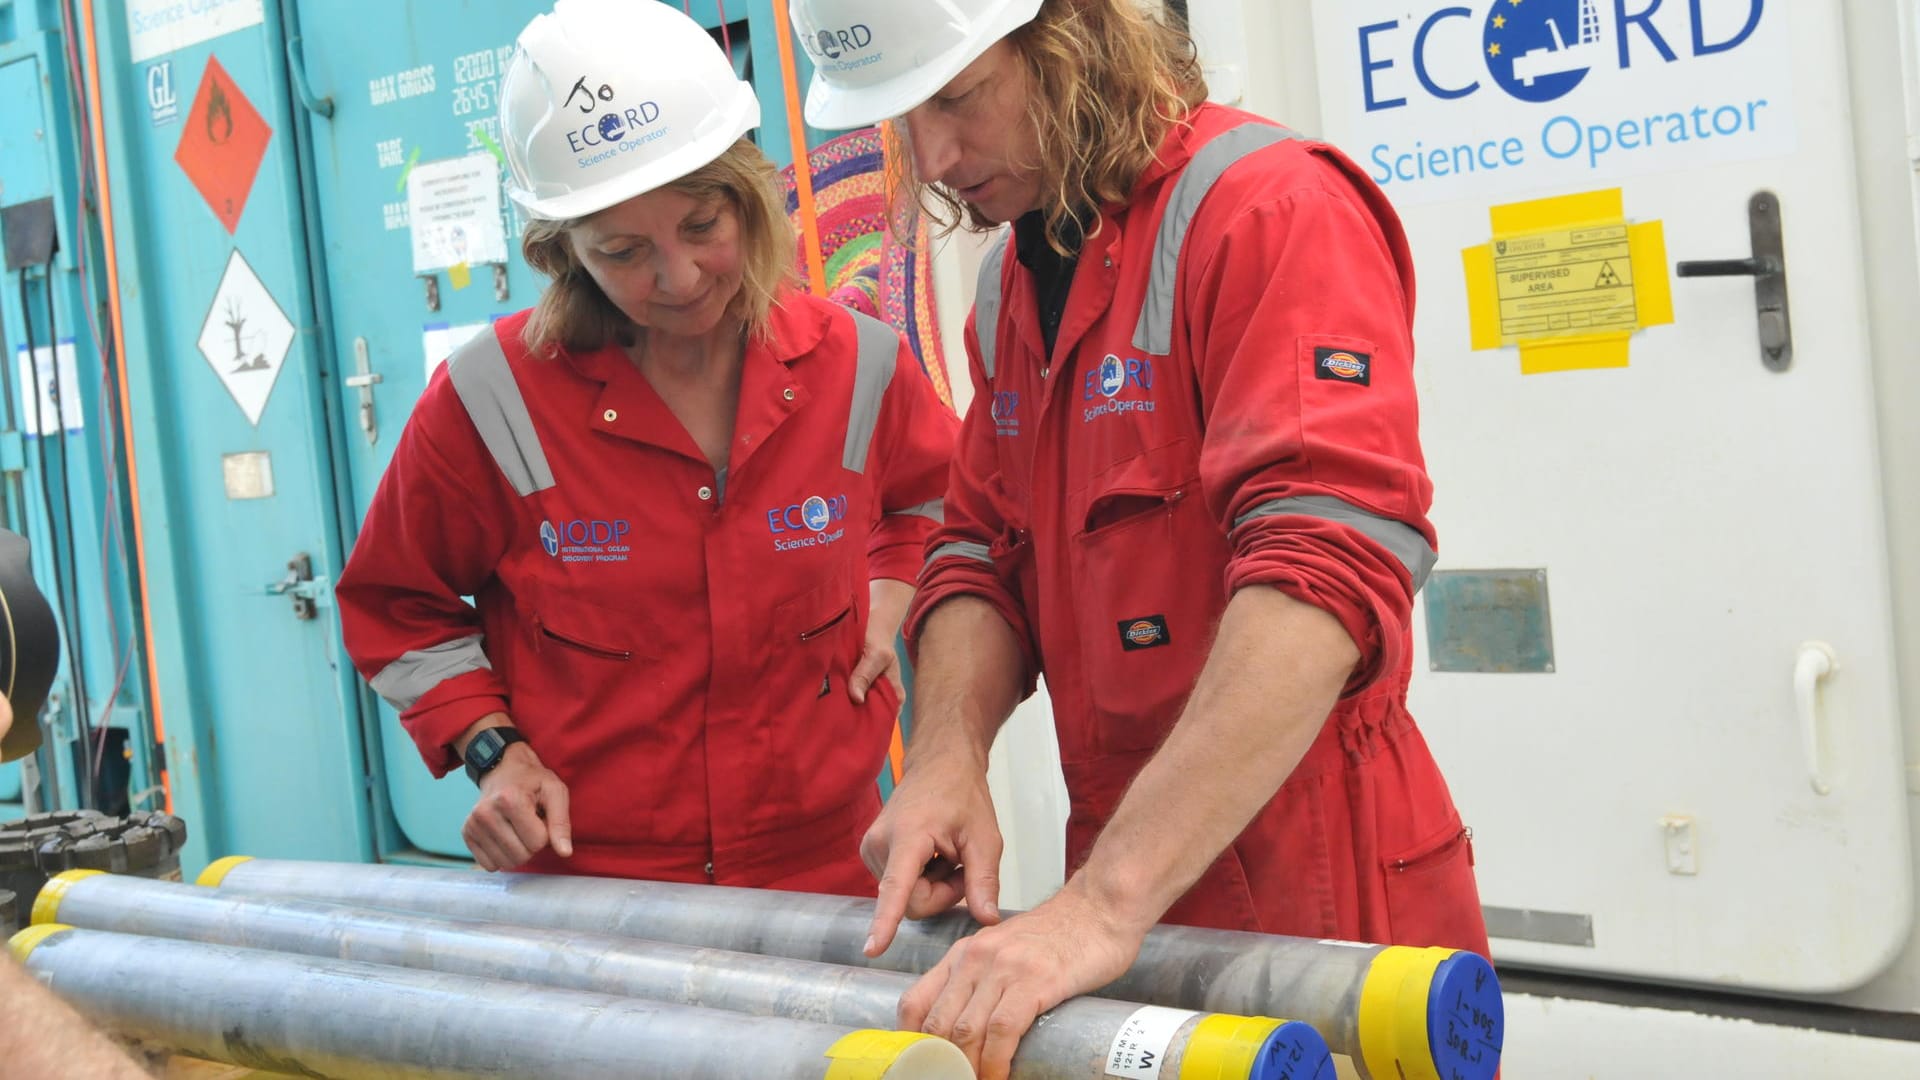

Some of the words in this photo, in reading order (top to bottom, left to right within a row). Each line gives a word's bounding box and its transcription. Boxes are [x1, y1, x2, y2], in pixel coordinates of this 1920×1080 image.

[454, 49, 496, 84] 12000
[1357, 0, 1766, 113] ECORD
[147, 62, 177, 109] GL
[369, 75, 398, 106] MAX
[398, 64, 436, 99] GROSS
[563, 75, 614, 114] Jo
[566, 101, 660, 153] ECORD
[1370, 136, 1525, 185] Science
[1541, 99, 1768, 168] Operator
[578, 147, 617, 169] Science
[618, 126, 669, 153] Operator
[1509, 268, 1570, 283] SUPERVISED
[1527, 283, 1554, 293] AREA
[560, 519, 630, 545] IODP
[774, 537, 816, 551] Science
[1112, 1051, 1123, 1069] 364
[1124, 1053, 1134, 1069] 121
[1138, 1050, 1155, 1069] W
